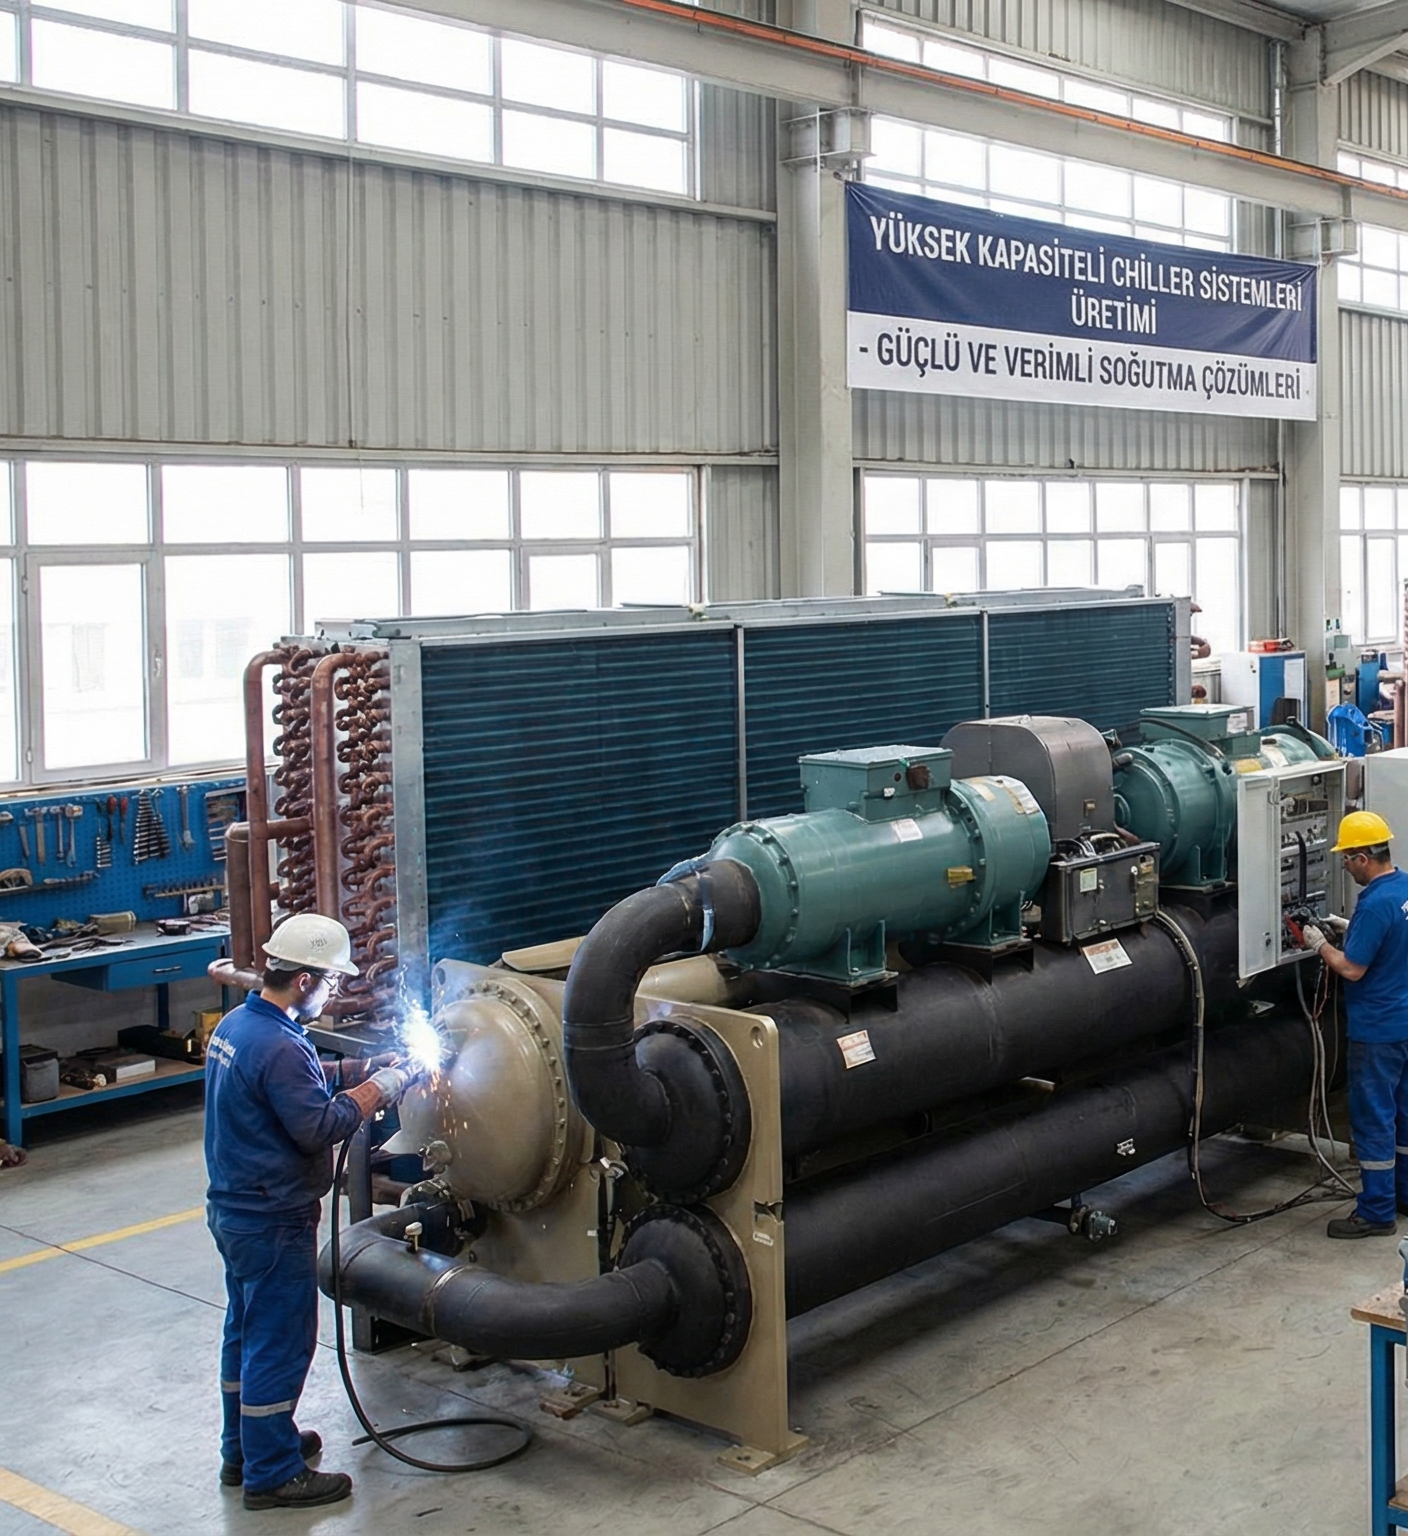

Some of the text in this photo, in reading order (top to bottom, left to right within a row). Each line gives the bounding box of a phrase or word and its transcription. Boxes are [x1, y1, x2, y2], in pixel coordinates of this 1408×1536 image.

[869, 211, 1302, 311] YÜKSEK KAPASİTELİ CHİLLER SİSTEMLERİ
[1071, 289, 1157, 335] ÜRETİMİ
[877, 327, 960, 378] GÜÇLÜ
[967, 342, 997, 374] VE
[1005, 342, 1094, 383] VERİMLİ
[1099, 350, 1196, 391] SOĞUTMA
[1202, 360, 1300, 400] ÇÖZÜMLERİ
